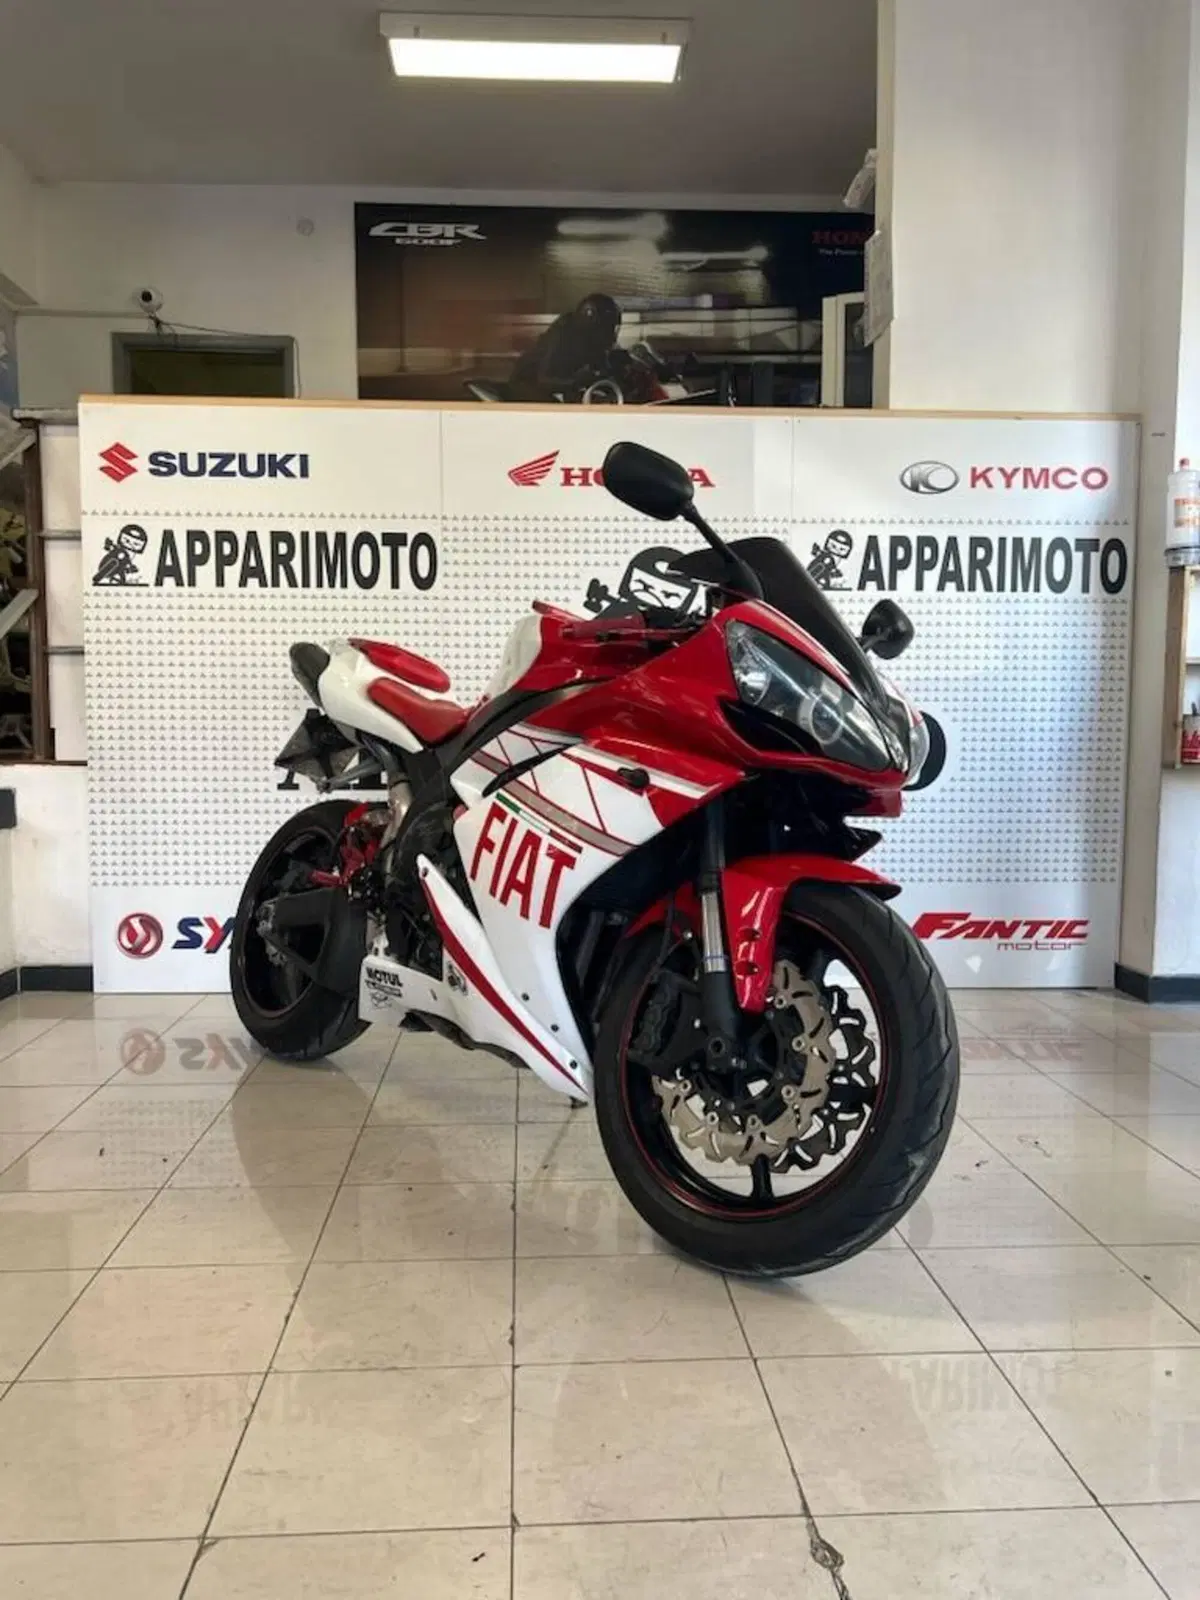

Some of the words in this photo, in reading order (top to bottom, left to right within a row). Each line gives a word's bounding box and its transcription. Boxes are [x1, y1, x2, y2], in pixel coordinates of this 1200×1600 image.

[369, 222, 487, 240] CBR
[812, 231, 866, 245] HON
[148, 451, 309, 478] SUZUKI
[970, 466, 1108, 490] KYMCO
[154, 529, 438, 590] APPARIMOTO
[857, 534, 1128, 594] APPARIMOTO
[470, 801, 577, 929] FIAT
[172, 916, 234, 954] SY
[912, 912, 1089, 939] FANTIC
[996, 940, 1089, 951] motor
